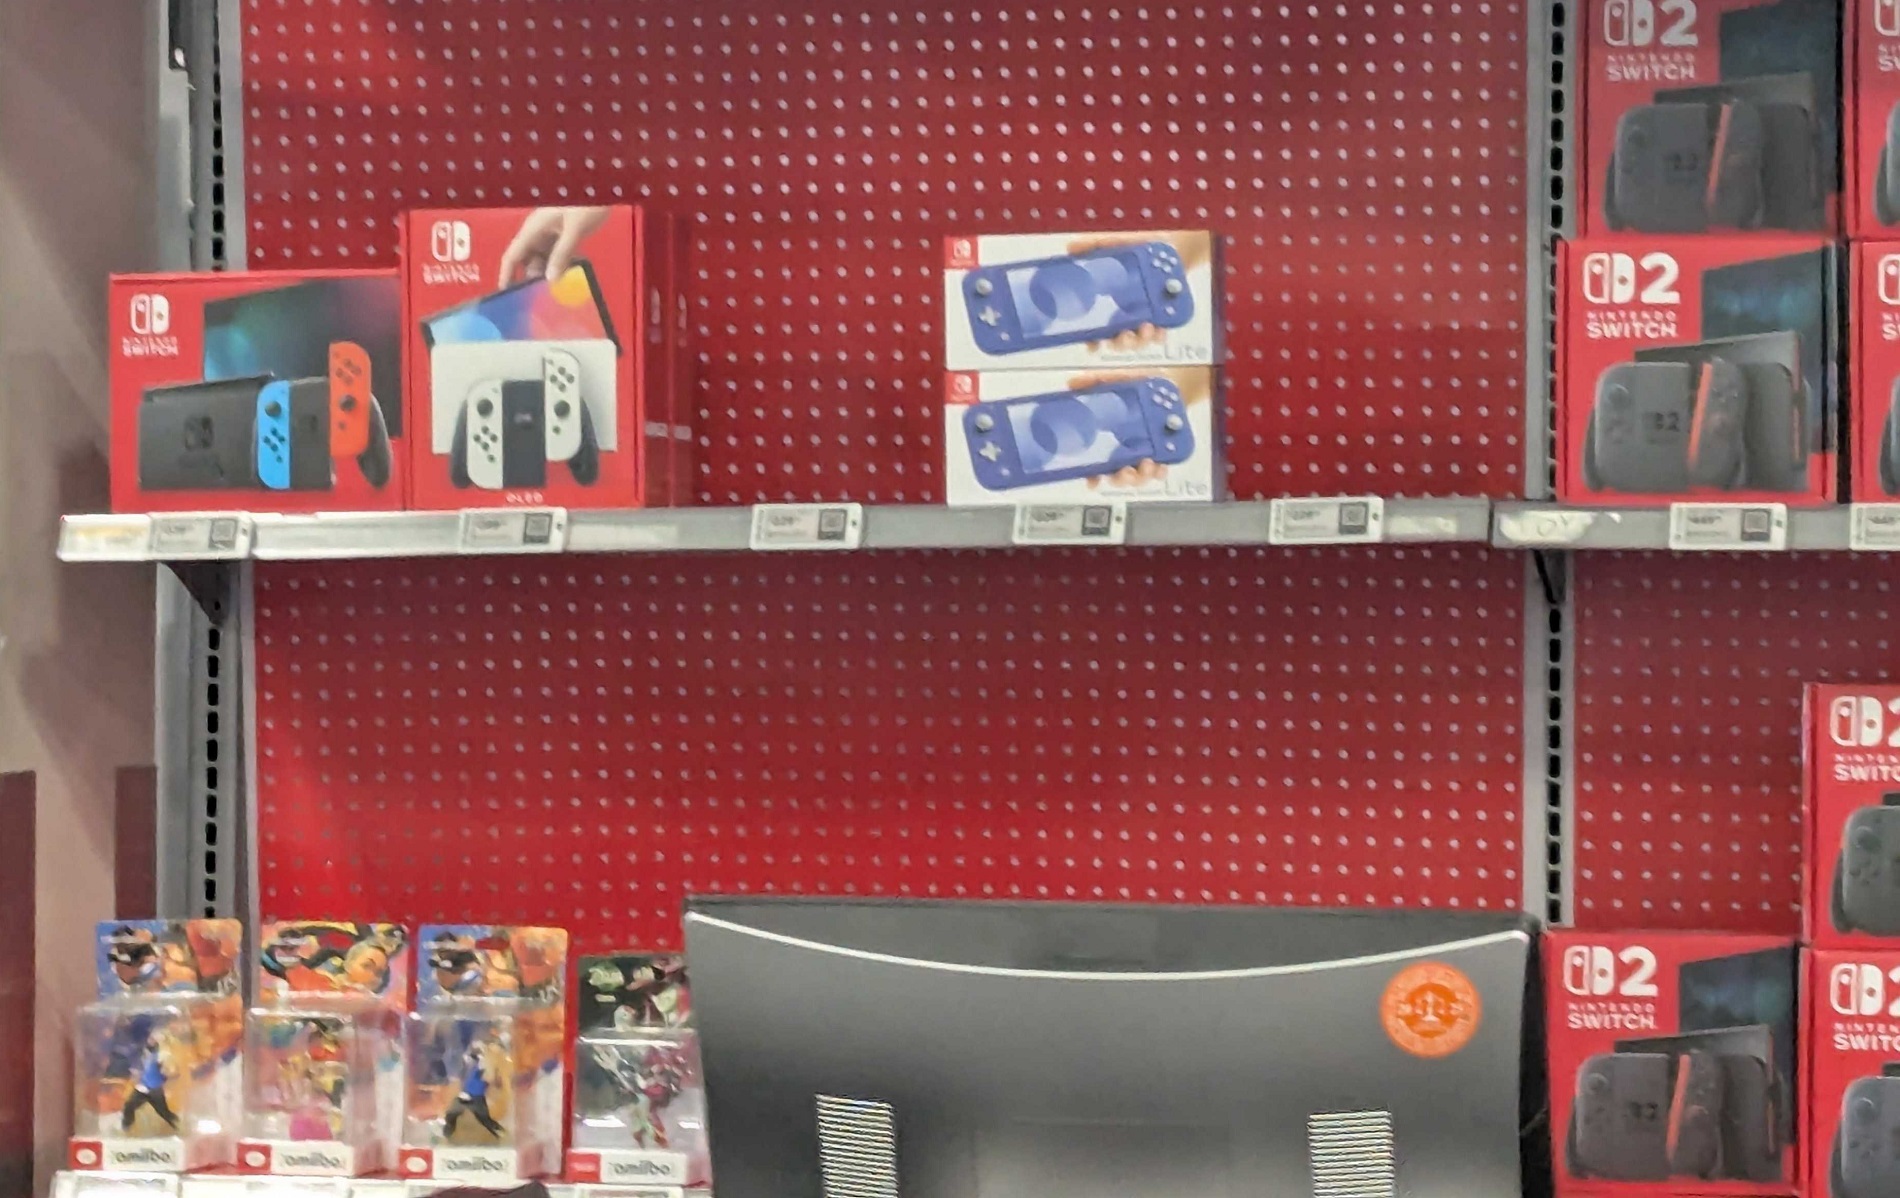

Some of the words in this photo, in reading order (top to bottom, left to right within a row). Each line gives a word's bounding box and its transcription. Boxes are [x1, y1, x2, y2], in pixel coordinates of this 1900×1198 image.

[1660, 0, 1699, 48] 2
[1606, 63, 1696, 81] SWITCH
[1639, 251, 1681, 304] 2
[1586, 321, 1678, 339] SWITCH
[1618, 945, 1659, 997] 2
[1567, 1012, 1658, 1030] SWITCH
